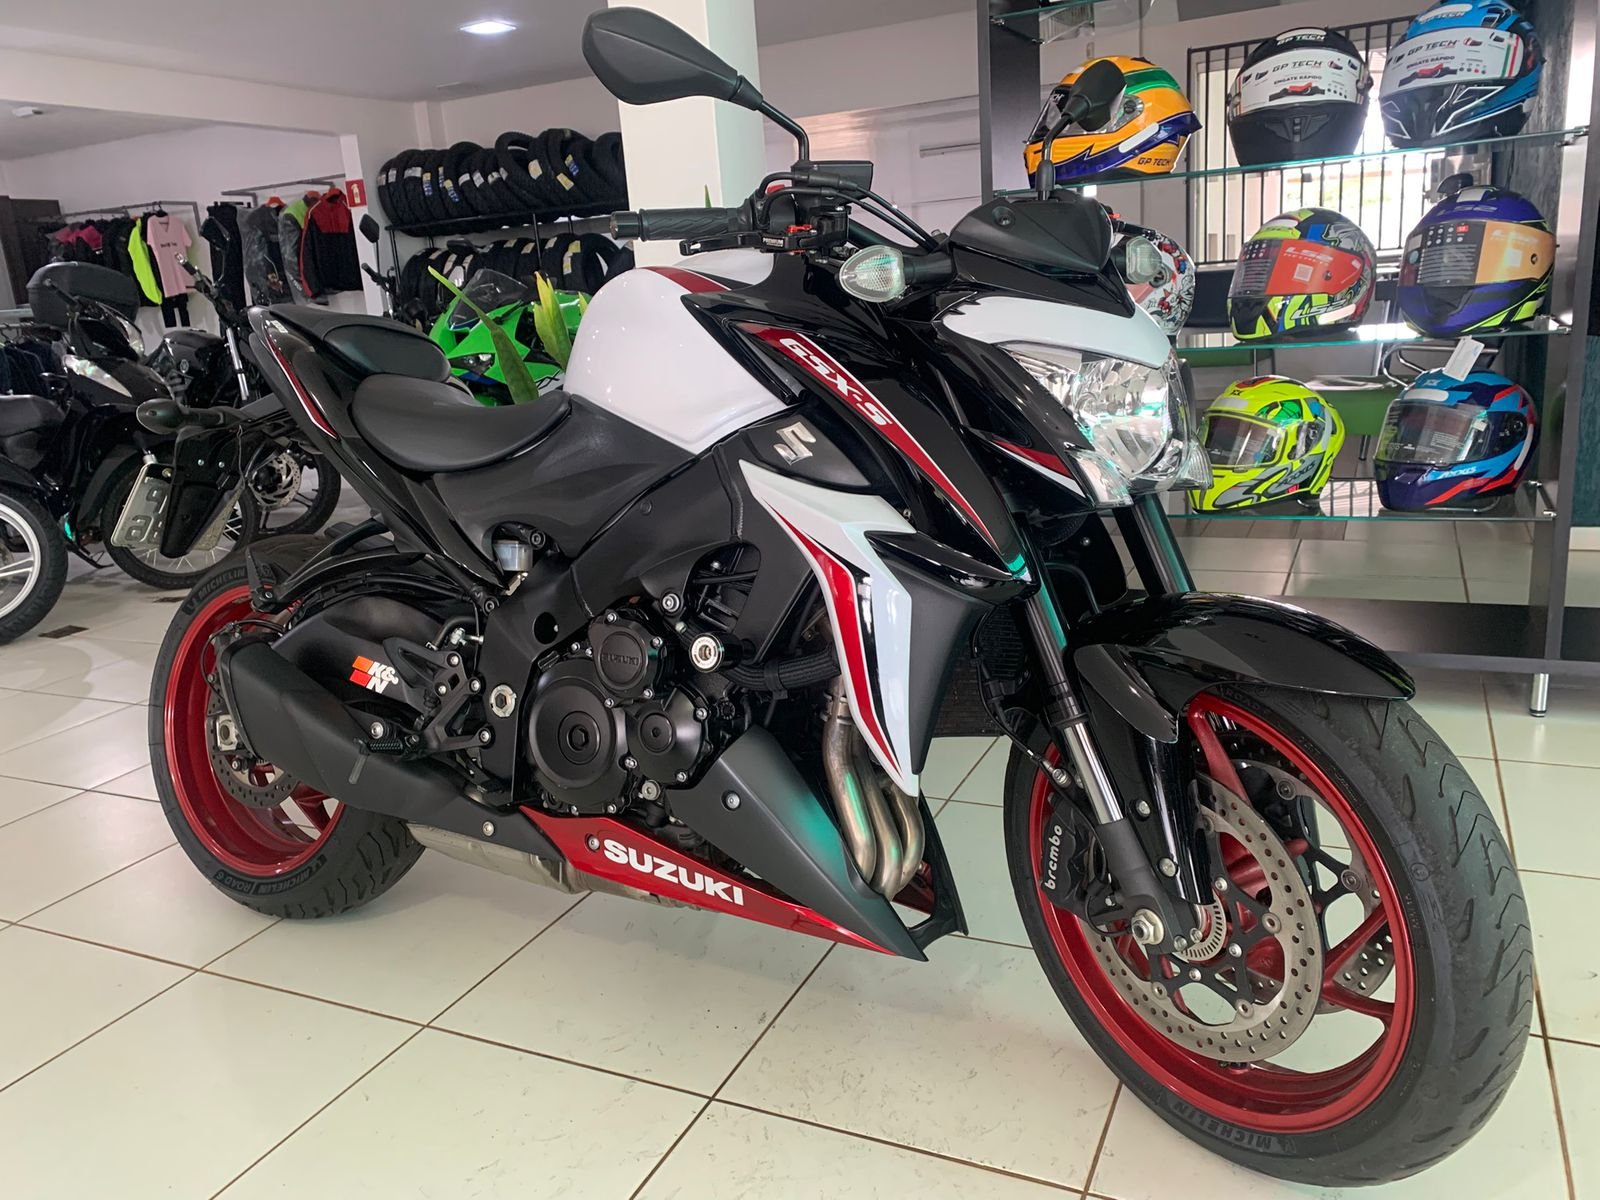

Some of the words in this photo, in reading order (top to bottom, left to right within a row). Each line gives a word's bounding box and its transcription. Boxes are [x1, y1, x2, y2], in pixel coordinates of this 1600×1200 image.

[1295, 33, 1326, 41] TECH
[1407, 45, 1424, 57] GP
[1425, 39, 1458, 51] TECH
[1272, 62, 1289, 73] GP
[1291, 60, 1323, 69] TECH
[1137, 157, 1153, 166] GP
[1153, 158, 1173, 167] TECH
[1285, 246, 1334, 263] LS2
[1290, 298, 1347, 320] LS2
[779, 338, 893, 426] GSX-S
[197, 566, 247, 599] MICHELIN
[602, 652, 640, 667] SUZUKI
[1044, 824, 1063, 890] brembo
[257, 870, 311, 894] MICHELIN
[603, 839, 745, 906] SUZUKI
[224, 875, 253, 892] ROAD
[1173, 1100, 1273, 1150] MICHELIN
